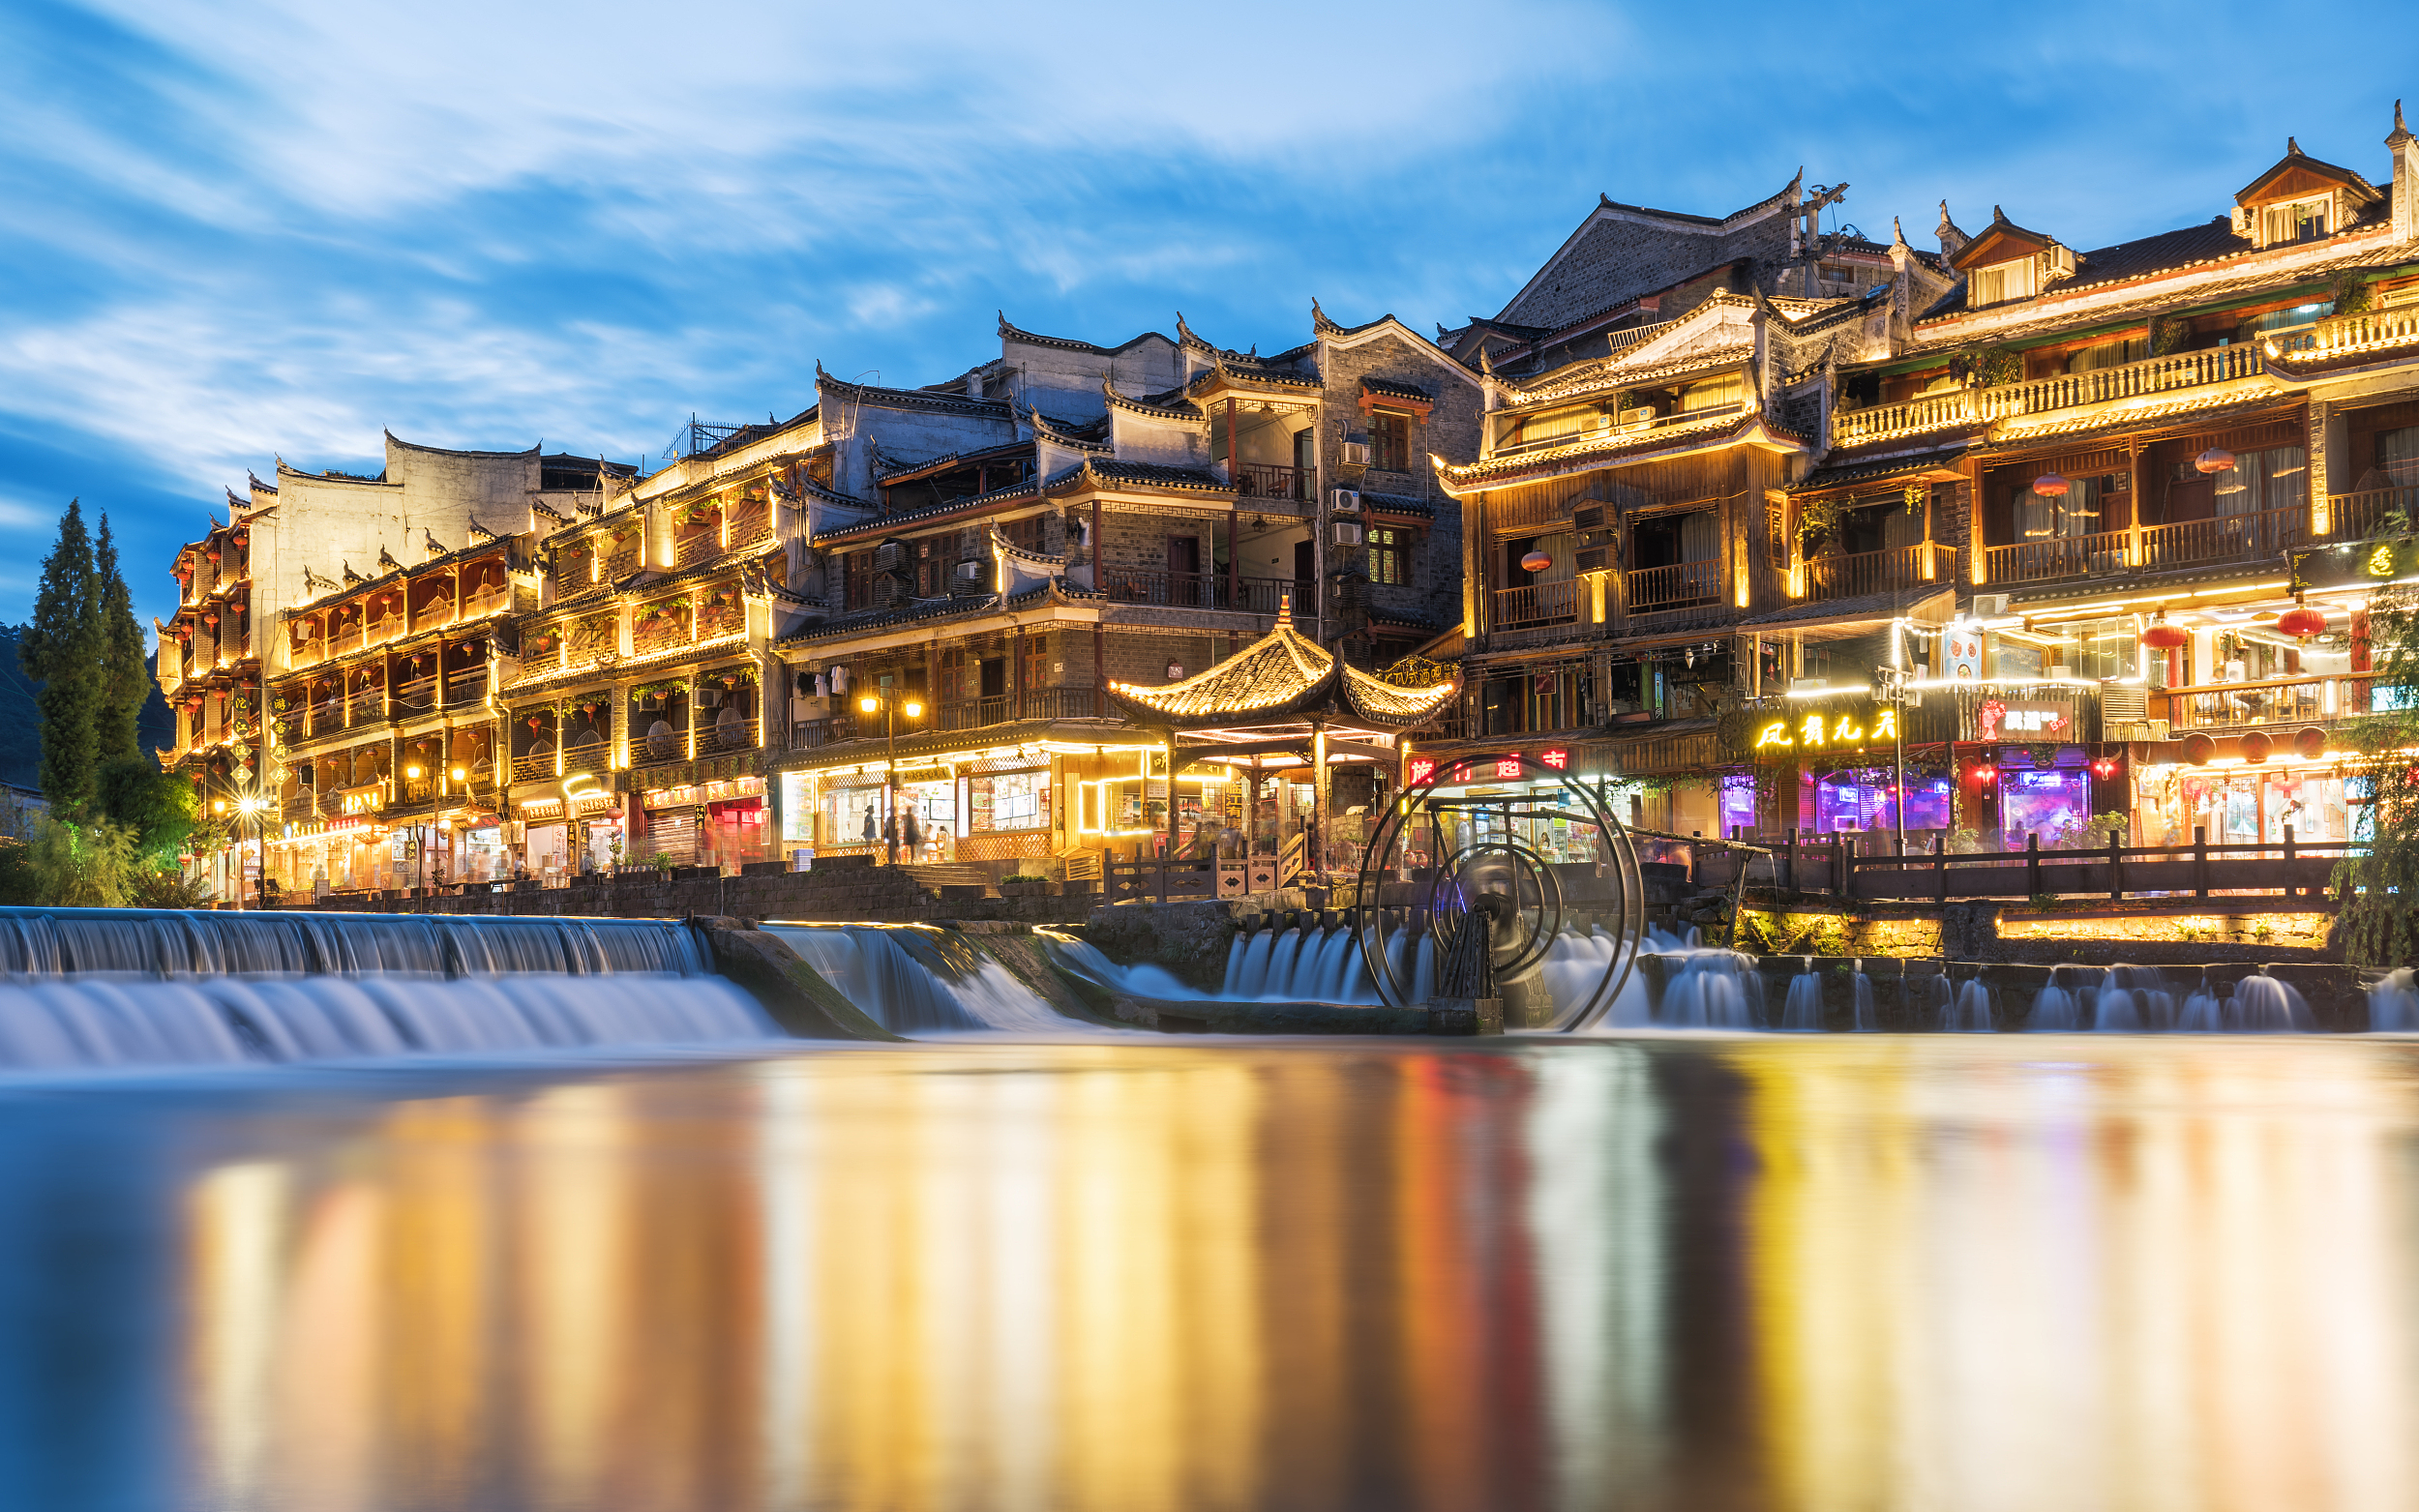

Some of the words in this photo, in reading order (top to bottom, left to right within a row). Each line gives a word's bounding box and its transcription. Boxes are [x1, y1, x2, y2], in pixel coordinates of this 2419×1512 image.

[235, 697, 249, 780] 沱江渔王
[273, 697, 287, 782] 游客厨房
[1755, 710, 1896, 748] 凤舞九天
[2047, 716, 2069, 732] Bar
